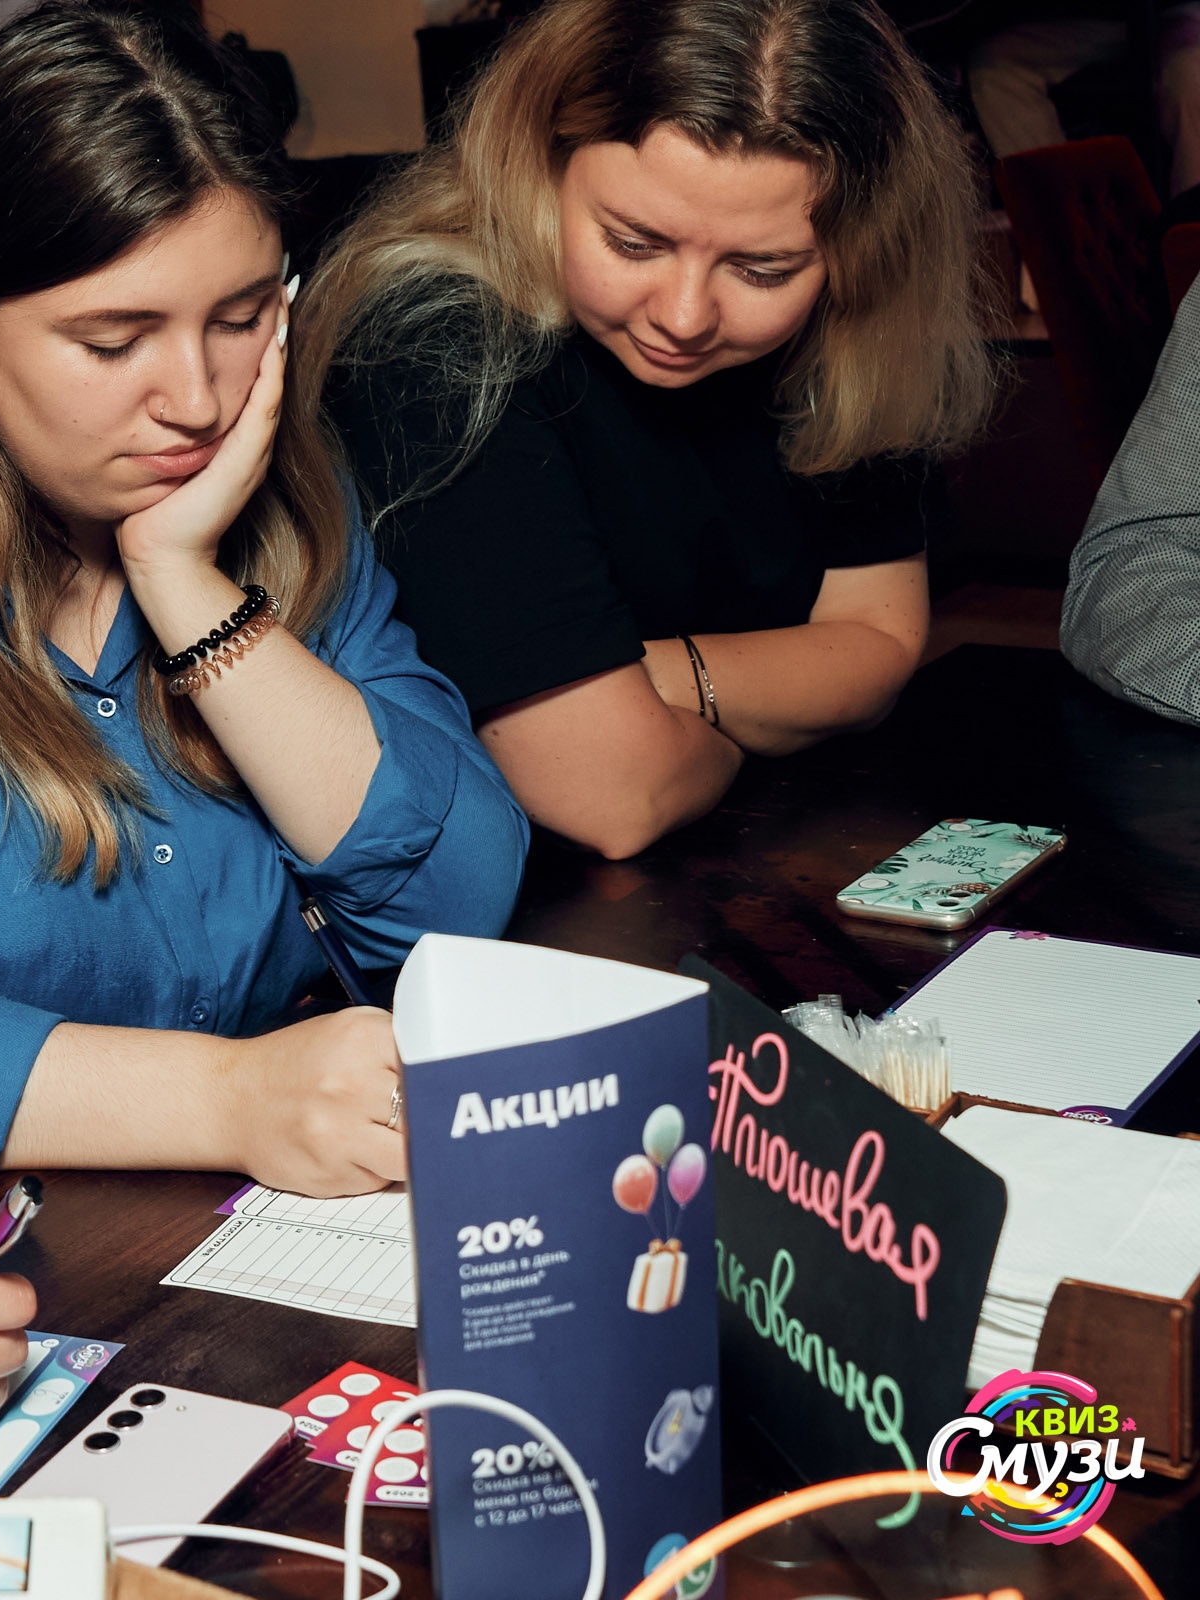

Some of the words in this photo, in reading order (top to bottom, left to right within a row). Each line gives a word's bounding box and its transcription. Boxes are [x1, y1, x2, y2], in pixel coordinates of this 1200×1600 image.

[451, 1073, 619, 1139] Акции
[457, 1214, 544, 1258] 20%
[459, 1259, 518, 1279] Скидка
[520, 1257, 531, 1270] в
[532, 1250, 570, 1268] день
[471, 1441, 556, 1479] 20%
[472, 1475, 530, 1494] Скидка
[532, 1471, 551, 1484] на
[474, 1493, 518, 1511] меню
[520, 1490, 541, 1504] по
[488, 1510, 505, 1526] 12
[506, 1508, 528, 1524] до
[530, 1502, 546, 1519] 17
